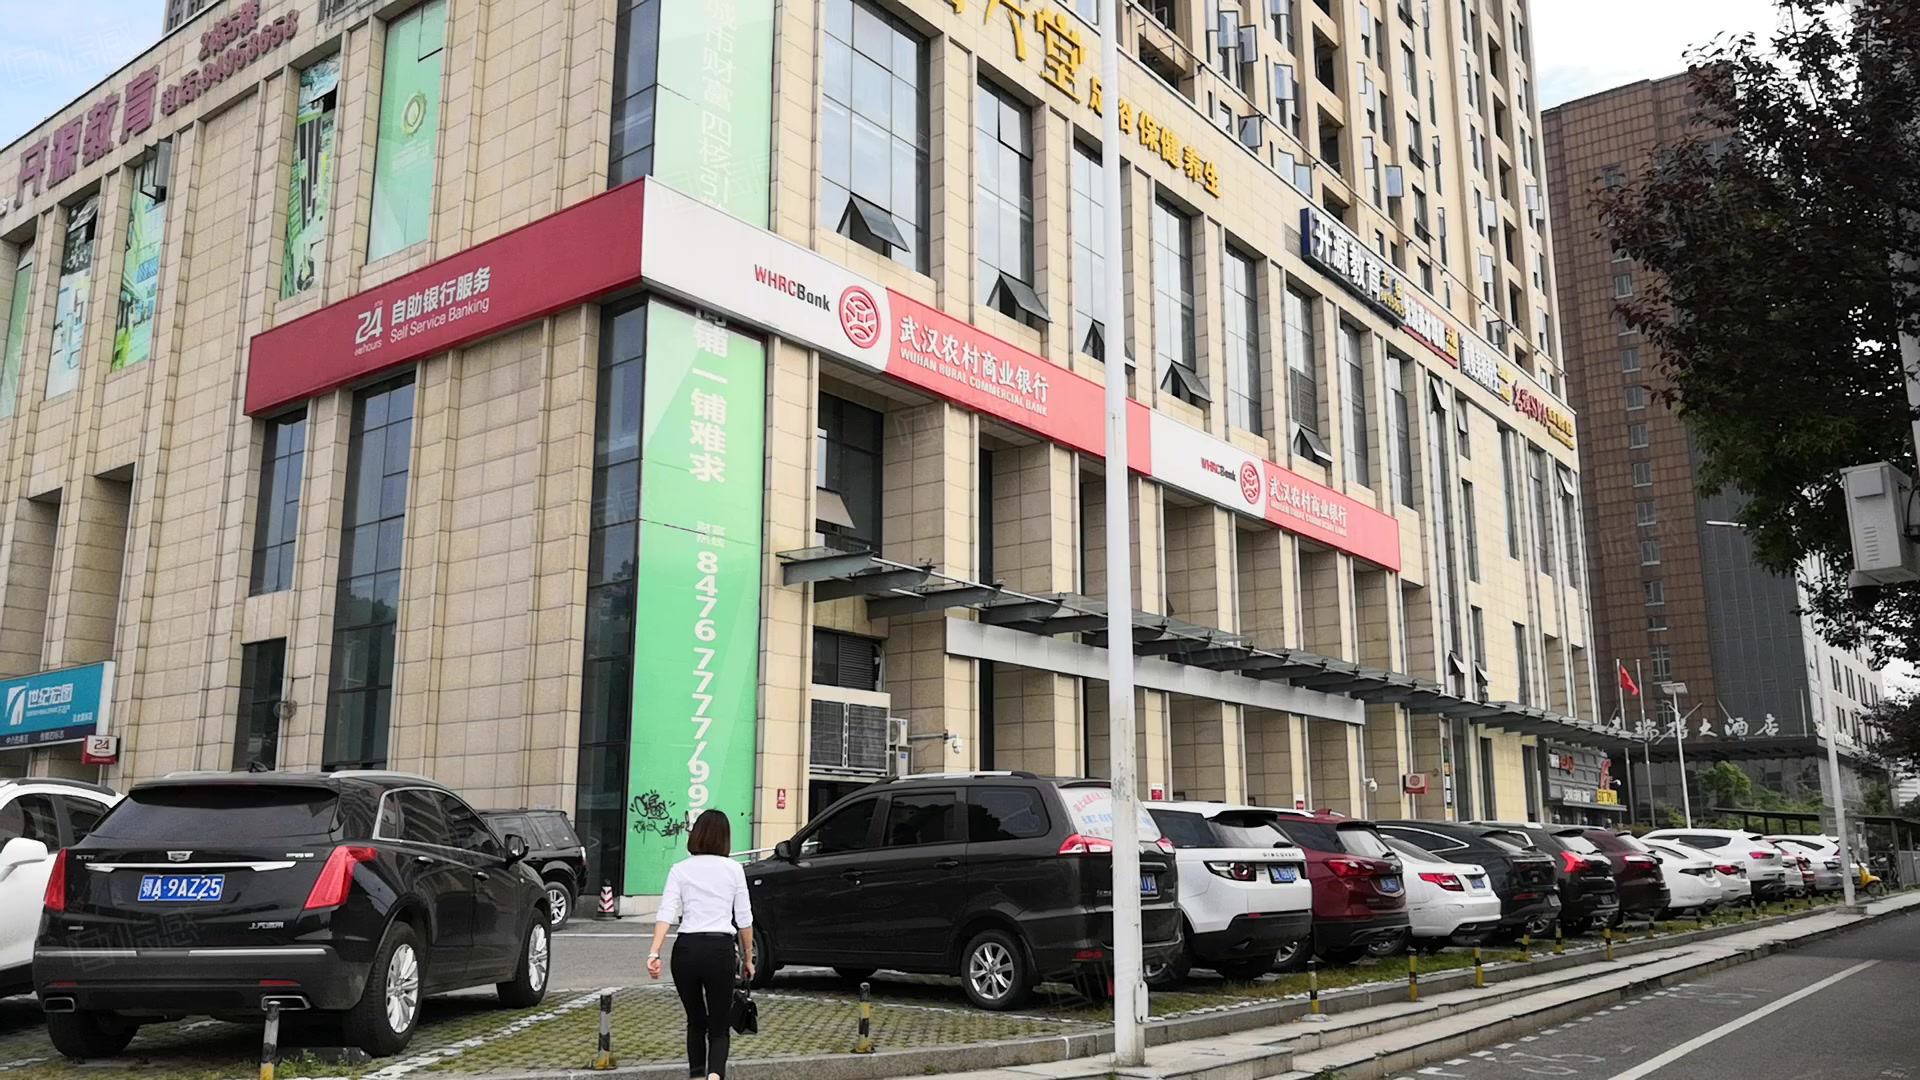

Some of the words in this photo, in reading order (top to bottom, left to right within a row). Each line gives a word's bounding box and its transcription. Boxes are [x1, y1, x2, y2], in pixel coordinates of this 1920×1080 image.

[699, 0, 738, 208] 城市财富四核引
[1310, 213, 1381, 302] 开源教育
[391, 265, 491, 327] 自助银行服务
[754, 264, 831, 312] WHRCBank
[389, 323, 408, 344] Self
[410, 312, 446, 336] Service
[448, 297, 490, 323] Banking
[900, 315, 1049, 404] 武汉农村商业银行
[900, 347, 937, 374] WUHAN
[939, 364, 967, 386] RURAL
[969, 375, 1025, 409] COMMERCIAL
[1025, 395, 1048, 417] BANK
[1200, 457, 1236, 482] WHRCBank
[1268, 475, 1348, 528] 武汉农村商业银行
[94, 739, 110, 750] 24
